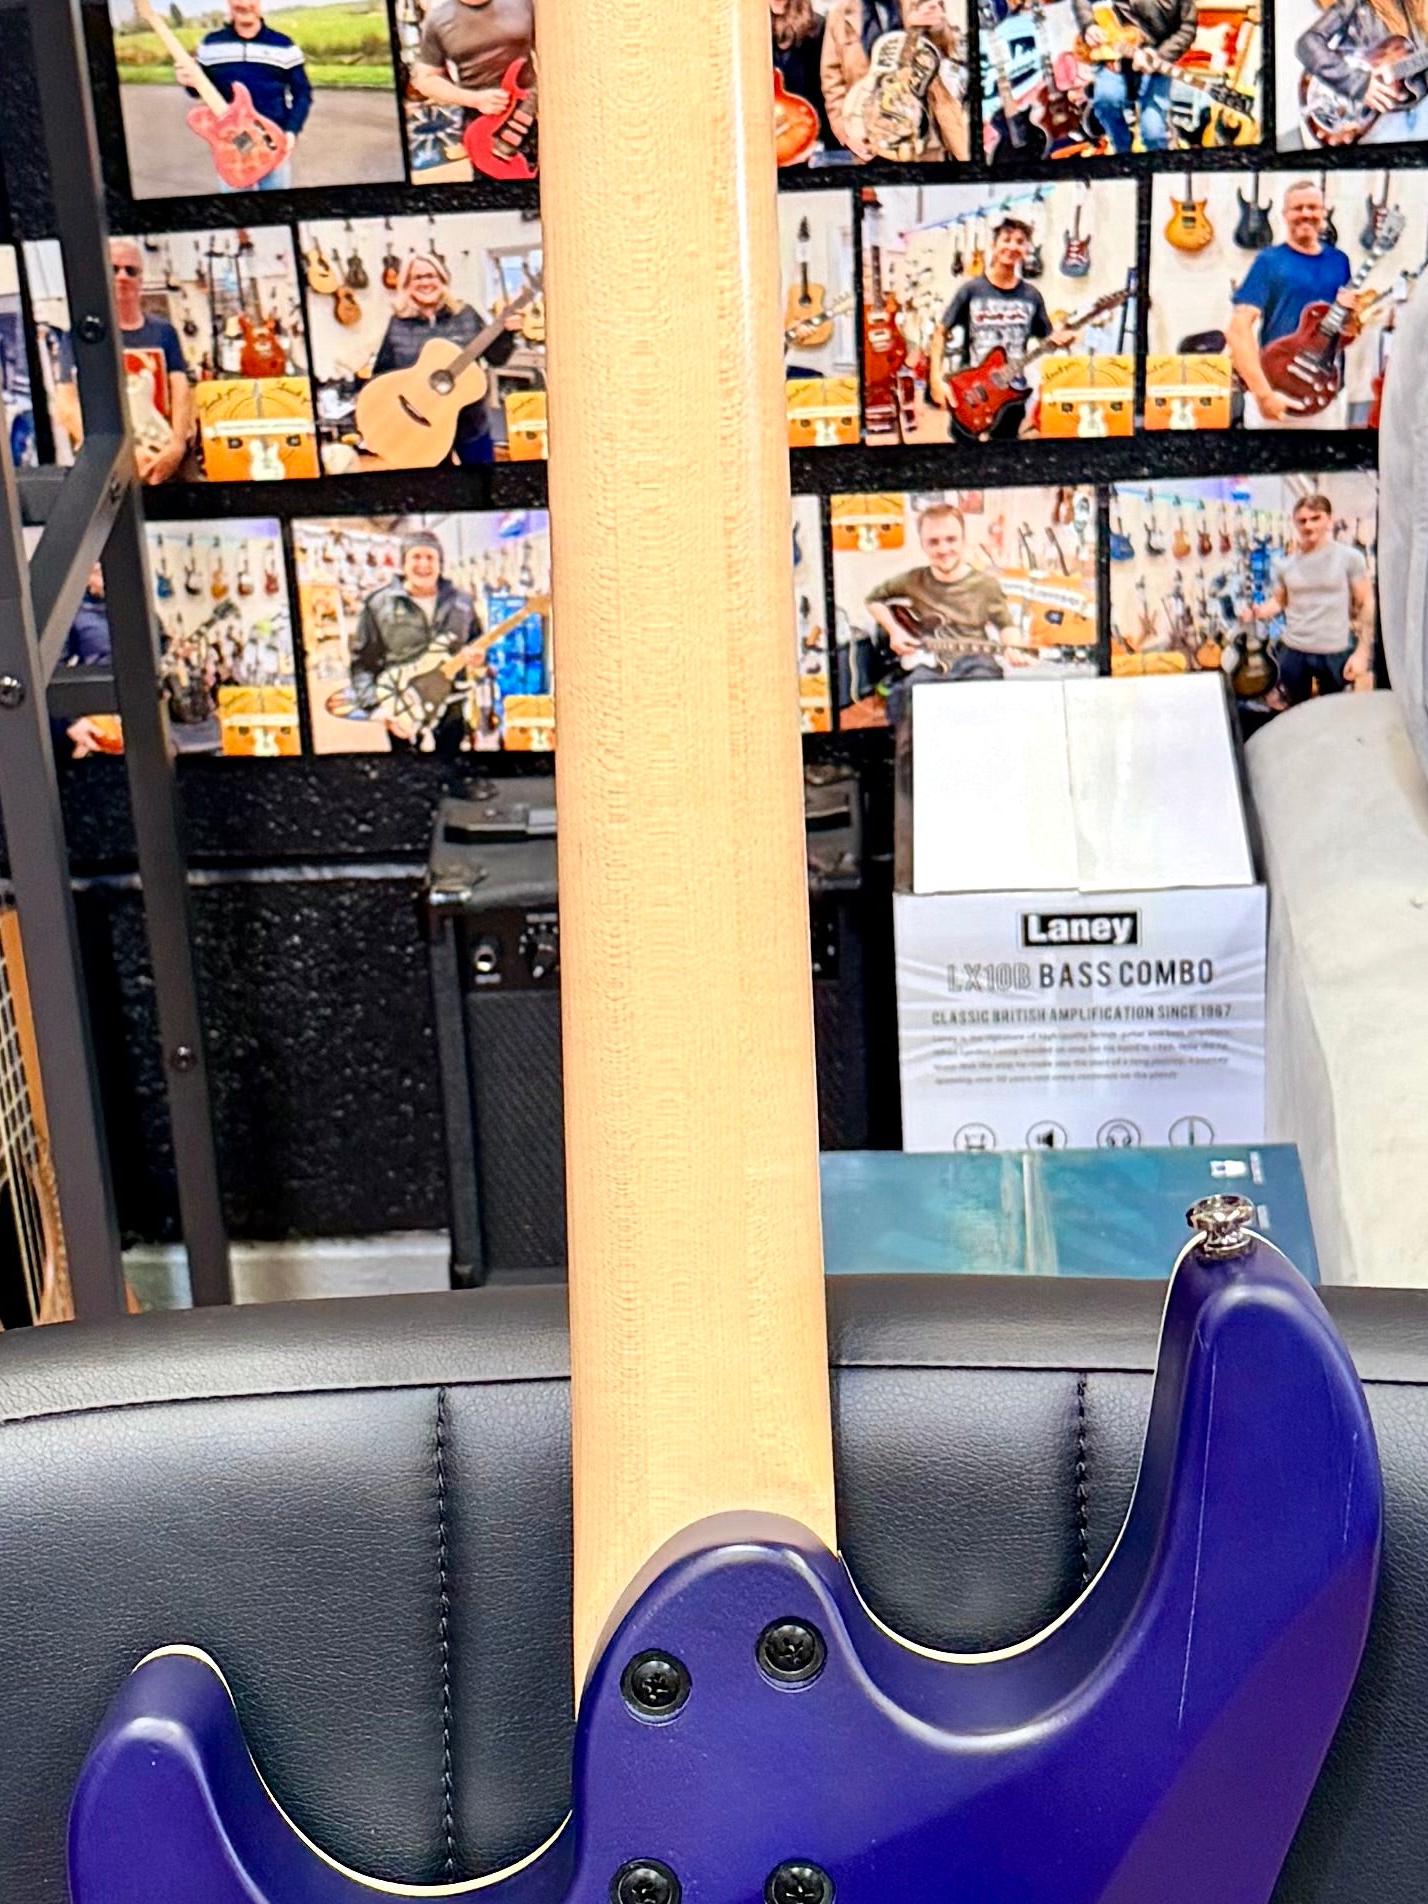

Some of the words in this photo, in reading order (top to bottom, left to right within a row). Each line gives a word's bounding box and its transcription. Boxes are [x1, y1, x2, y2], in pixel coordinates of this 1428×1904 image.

[1027, 913, 1134, 944] Laney
[946, 961, 1031, 993] LX10B
[1039, 960, 1112, 989] BASS
[1119, 957, 1214, 988] COMBO
[932, 1008, 989, 1026] CLASSIC
[992, 1007, 1046, 1024] BRITISH
[1049, 1005, 1154, 1022] AMPLIFICATION
[1157, 1004, 1197, 1020] SINCE
